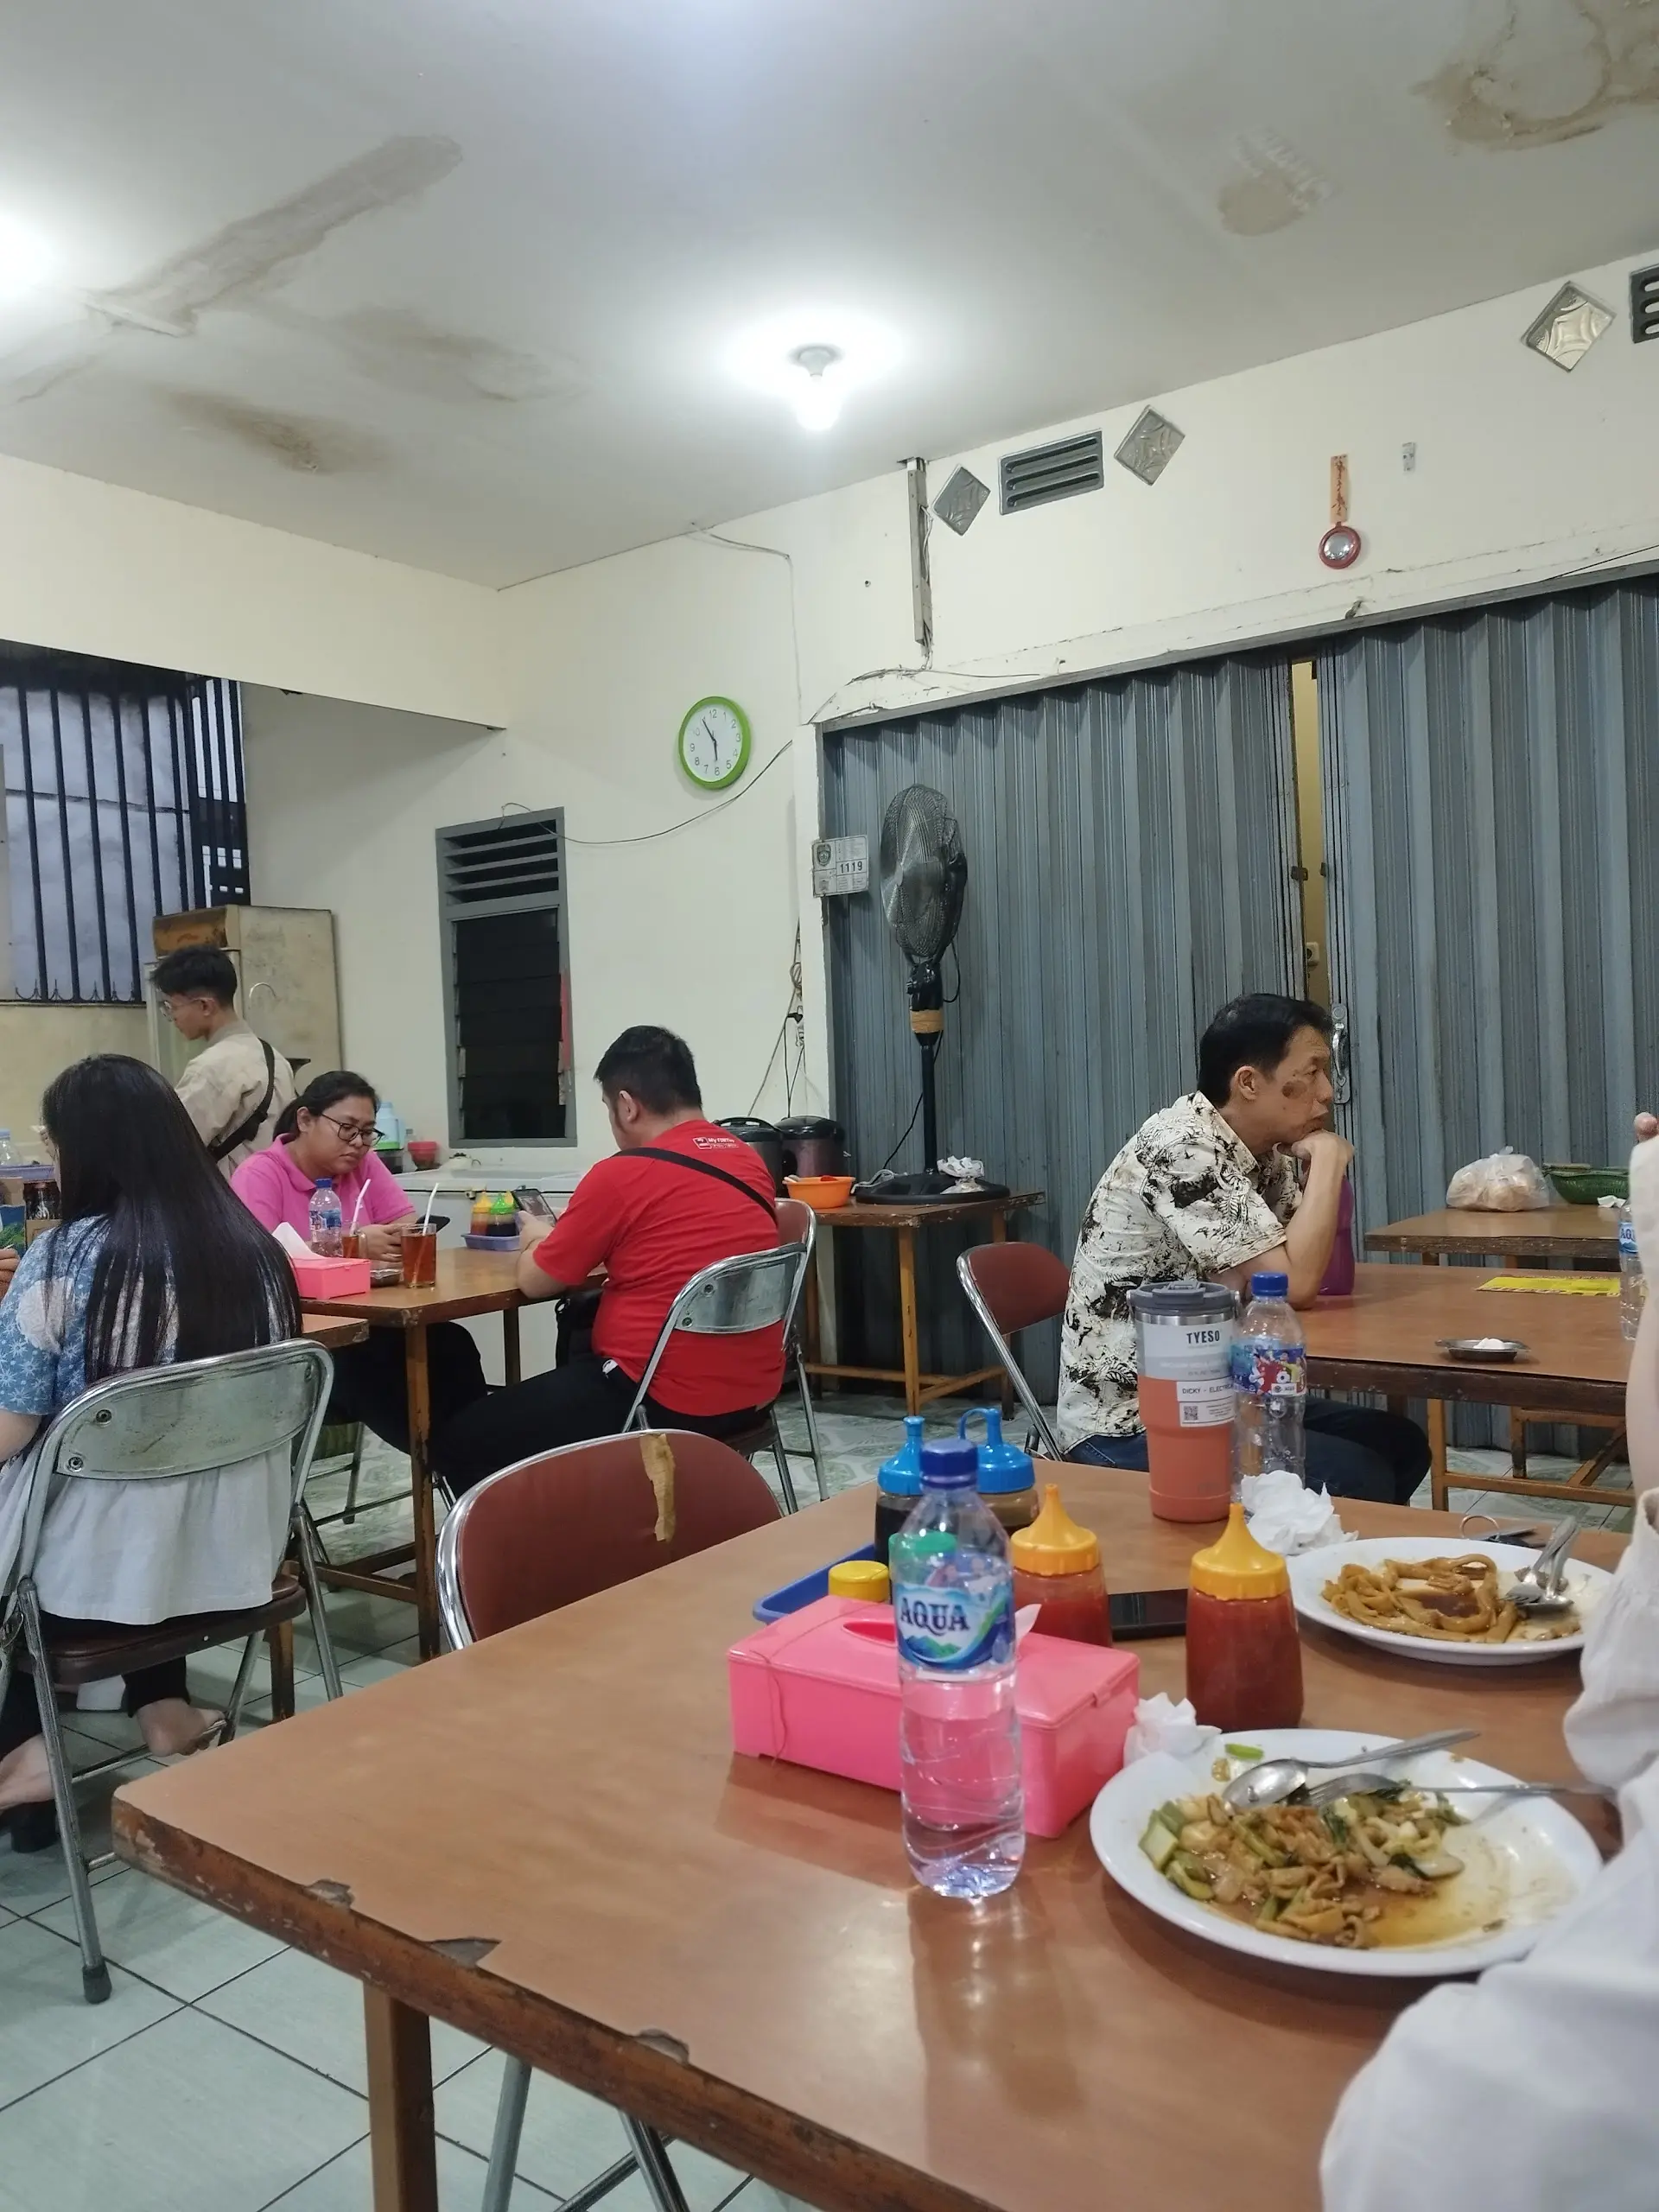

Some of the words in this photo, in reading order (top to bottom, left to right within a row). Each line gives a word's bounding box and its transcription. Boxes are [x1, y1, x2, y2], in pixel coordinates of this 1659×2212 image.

[709, 709, 717, 719] 12
[840, 861, 863, 874] 1119
[1186, 1330, 1220, 1344] TYESO
[899, 1597, 970, 1637] AQUA
